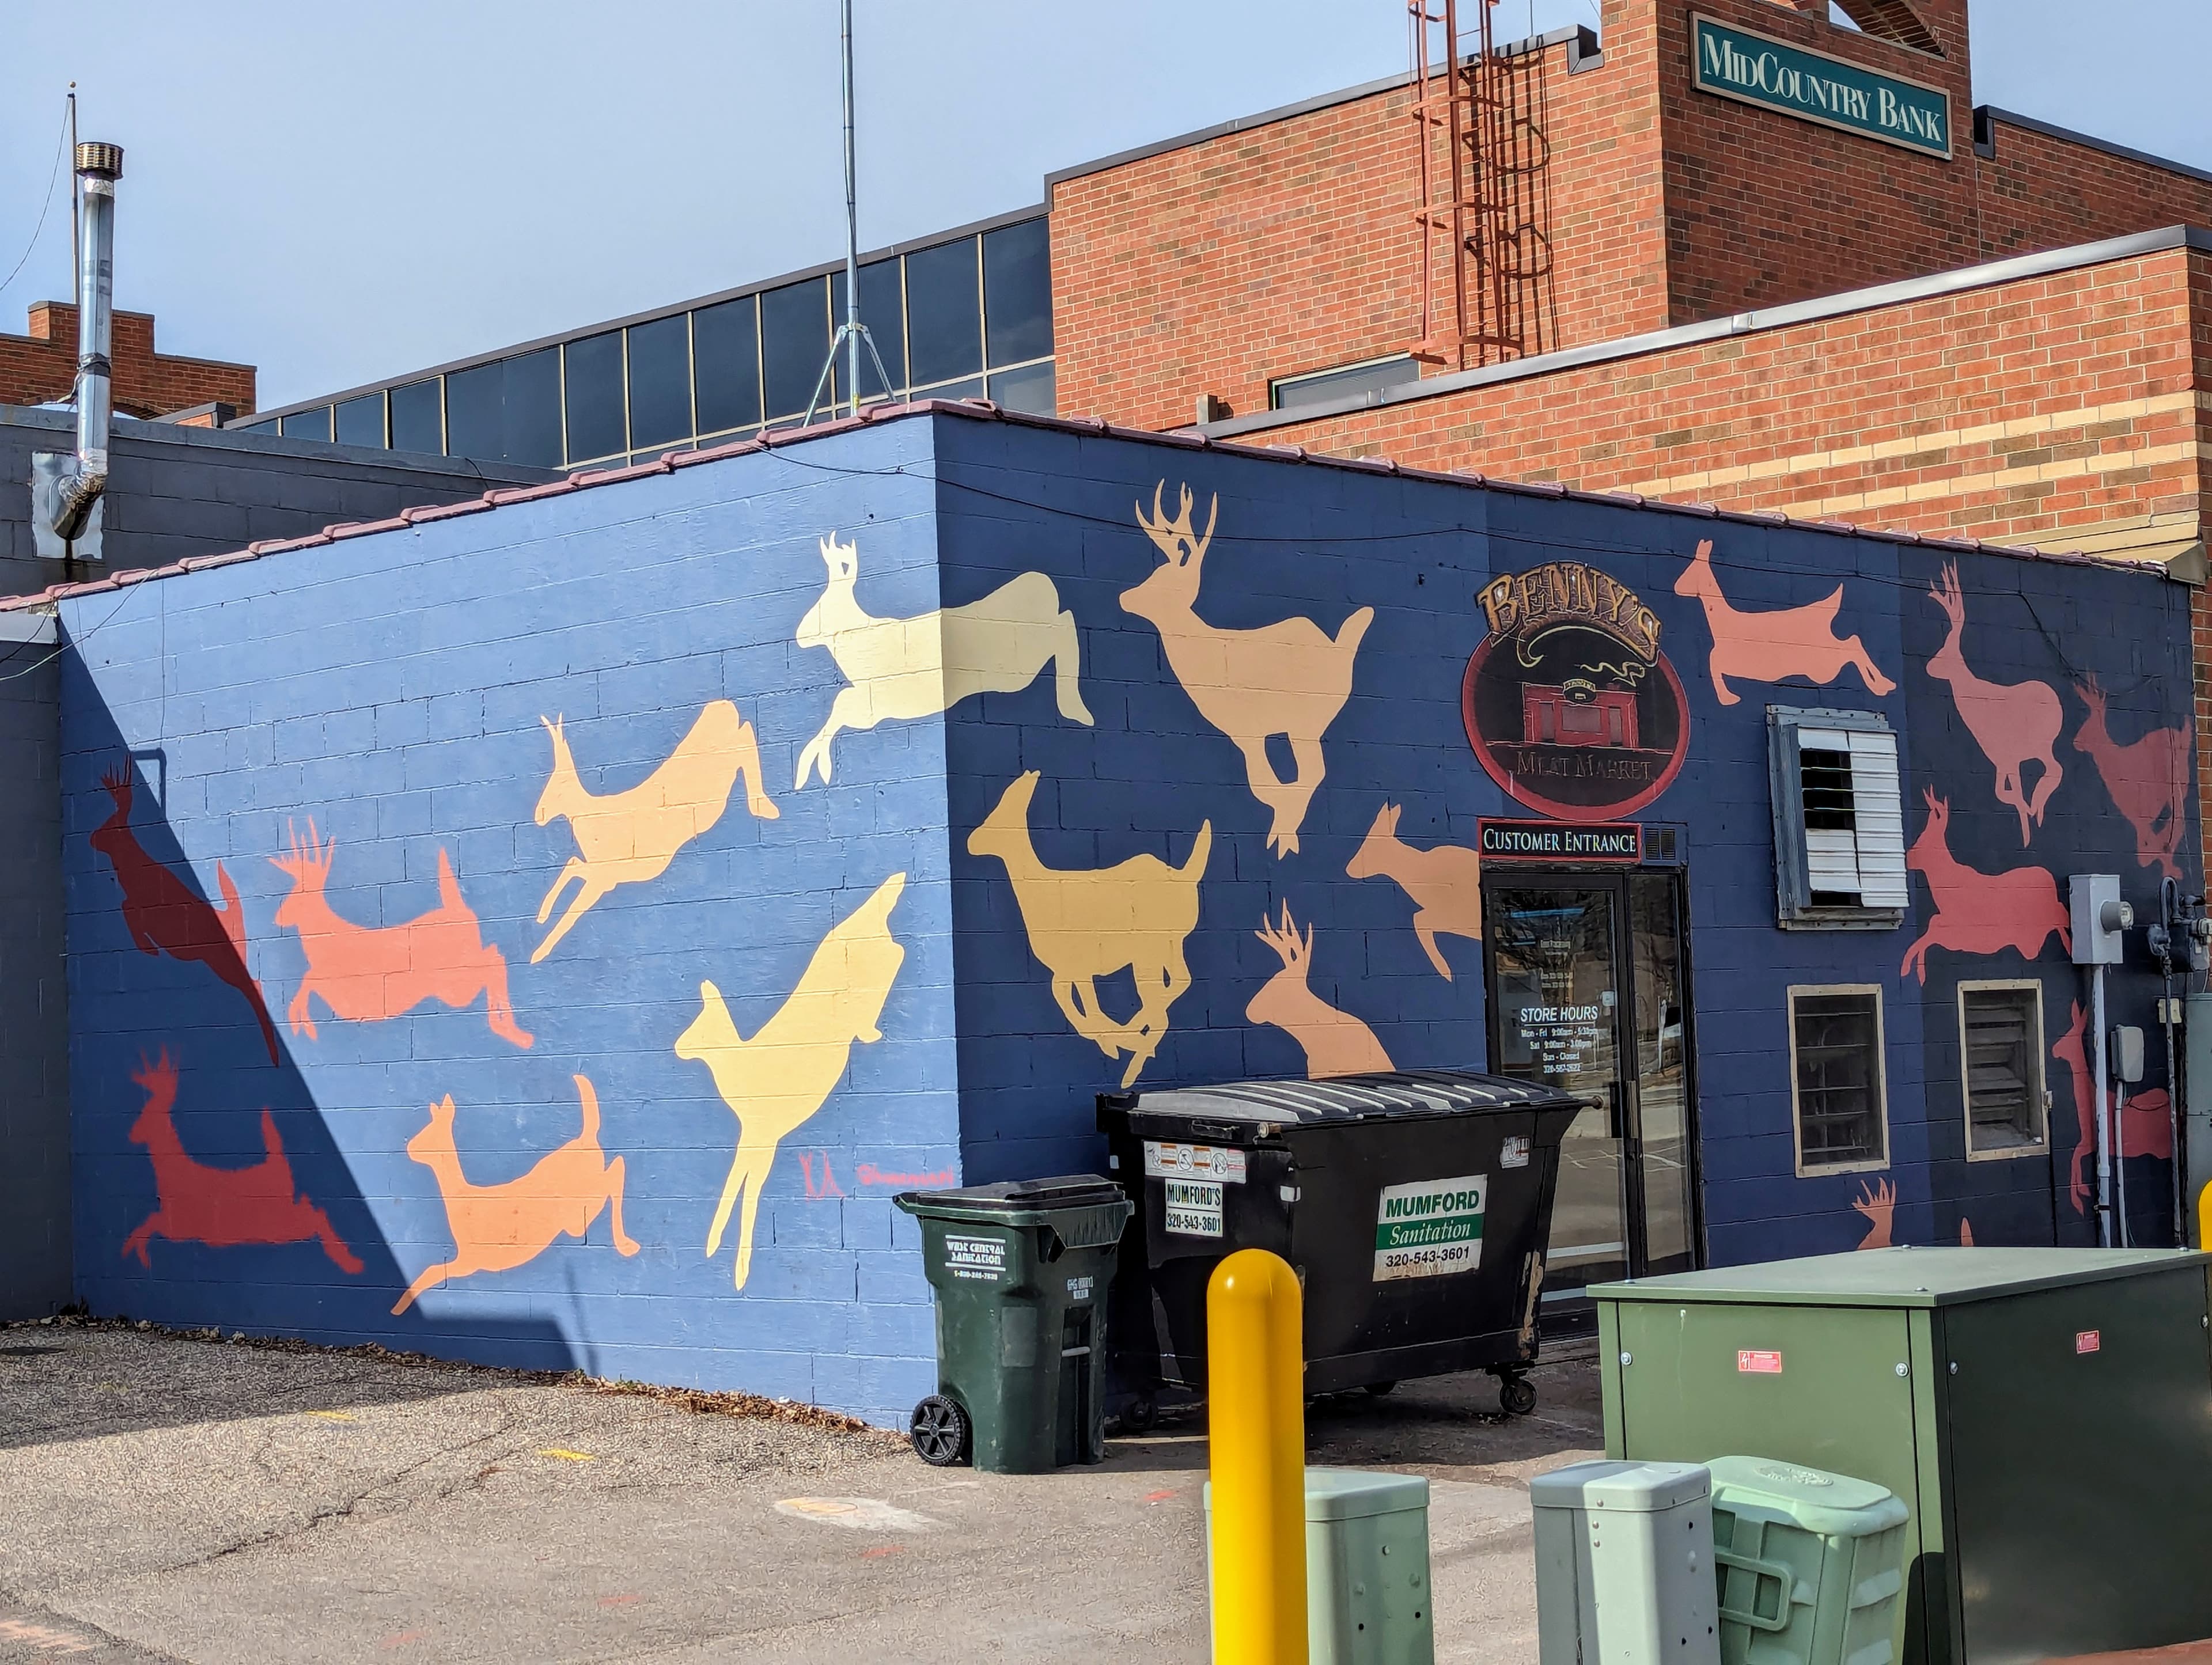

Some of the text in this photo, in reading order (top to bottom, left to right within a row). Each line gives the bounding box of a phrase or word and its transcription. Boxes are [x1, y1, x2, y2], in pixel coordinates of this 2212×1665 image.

[1702, 33, 1942, 142] MIDCOUNTRY BANK
[1483, 828, 1636, 852] CUSTOMER ENTRANCE
[1520, 1006, 1599, 1022] STORE HOURS
[1167, 1184, 1221, 1207] MUMFORD'S
[1386, 1190, 1479, 1218] MUMFORD
[1167, 1213, 1221, 1232] 320-543-3601
[1390, 1219, 1471, 1246] Sanitation
[1386, 1246, 1469, 1267] 320-543-3601
